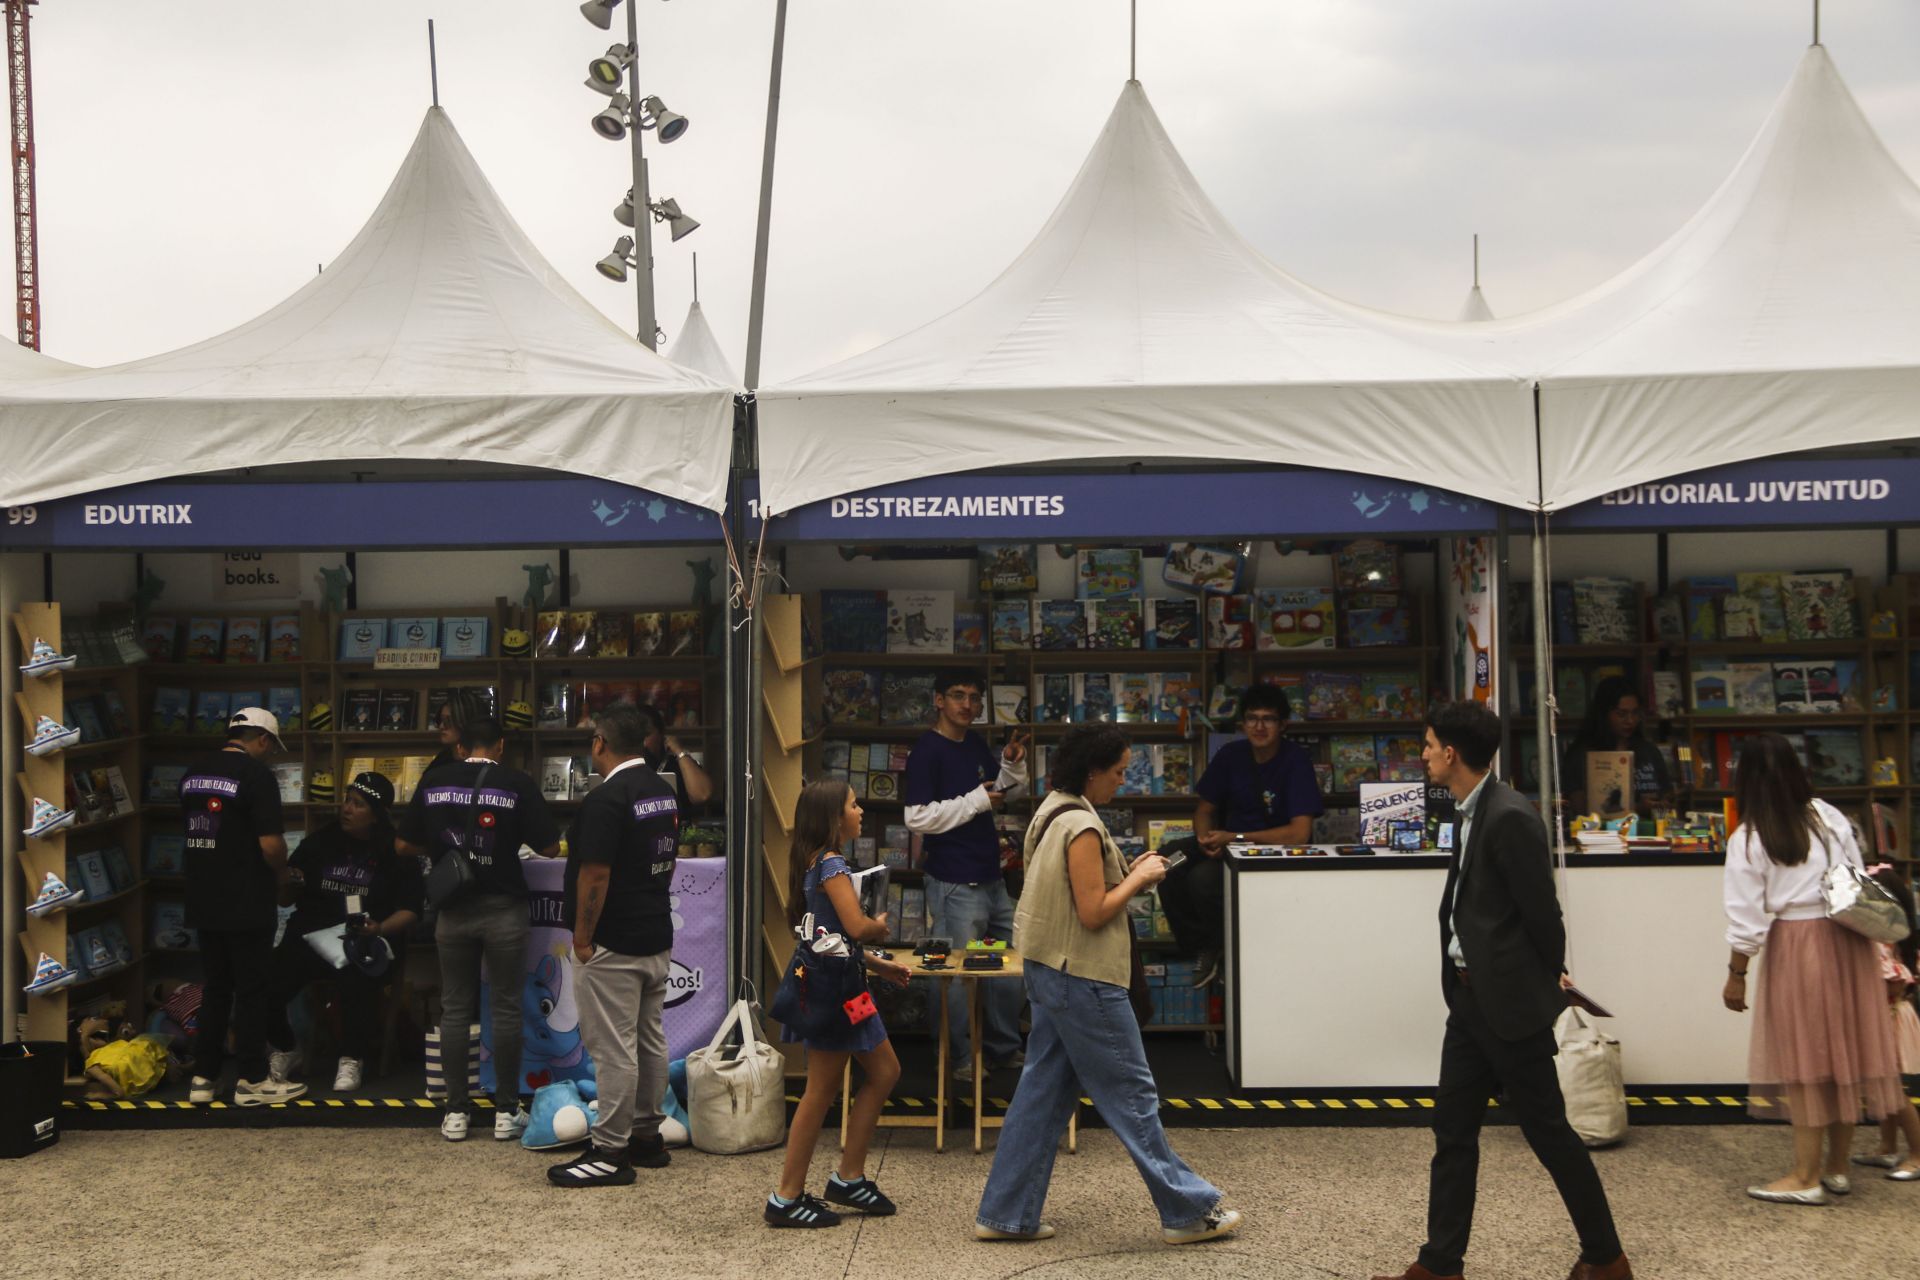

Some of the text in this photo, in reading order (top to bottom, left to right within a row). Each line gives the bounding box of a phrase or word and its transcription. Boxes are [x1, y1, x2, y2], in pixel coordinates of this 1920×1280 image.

[1744, 479, 1890, 503] JUVENTUD
[7, 505, 38, 525] 99
[84, 504, 192, 525] EDUTRIX
[831, 495, 1065, 518] DESTREZAMENTES
[225, 568, 280, 585] books.
[377, 651, 438, 664] READING CORNER
[453, 793, 464, 803] TUS
[485, 795, 515, 809] REALIDAD
[1360, 787, 1424, 814] SEQUENCE
